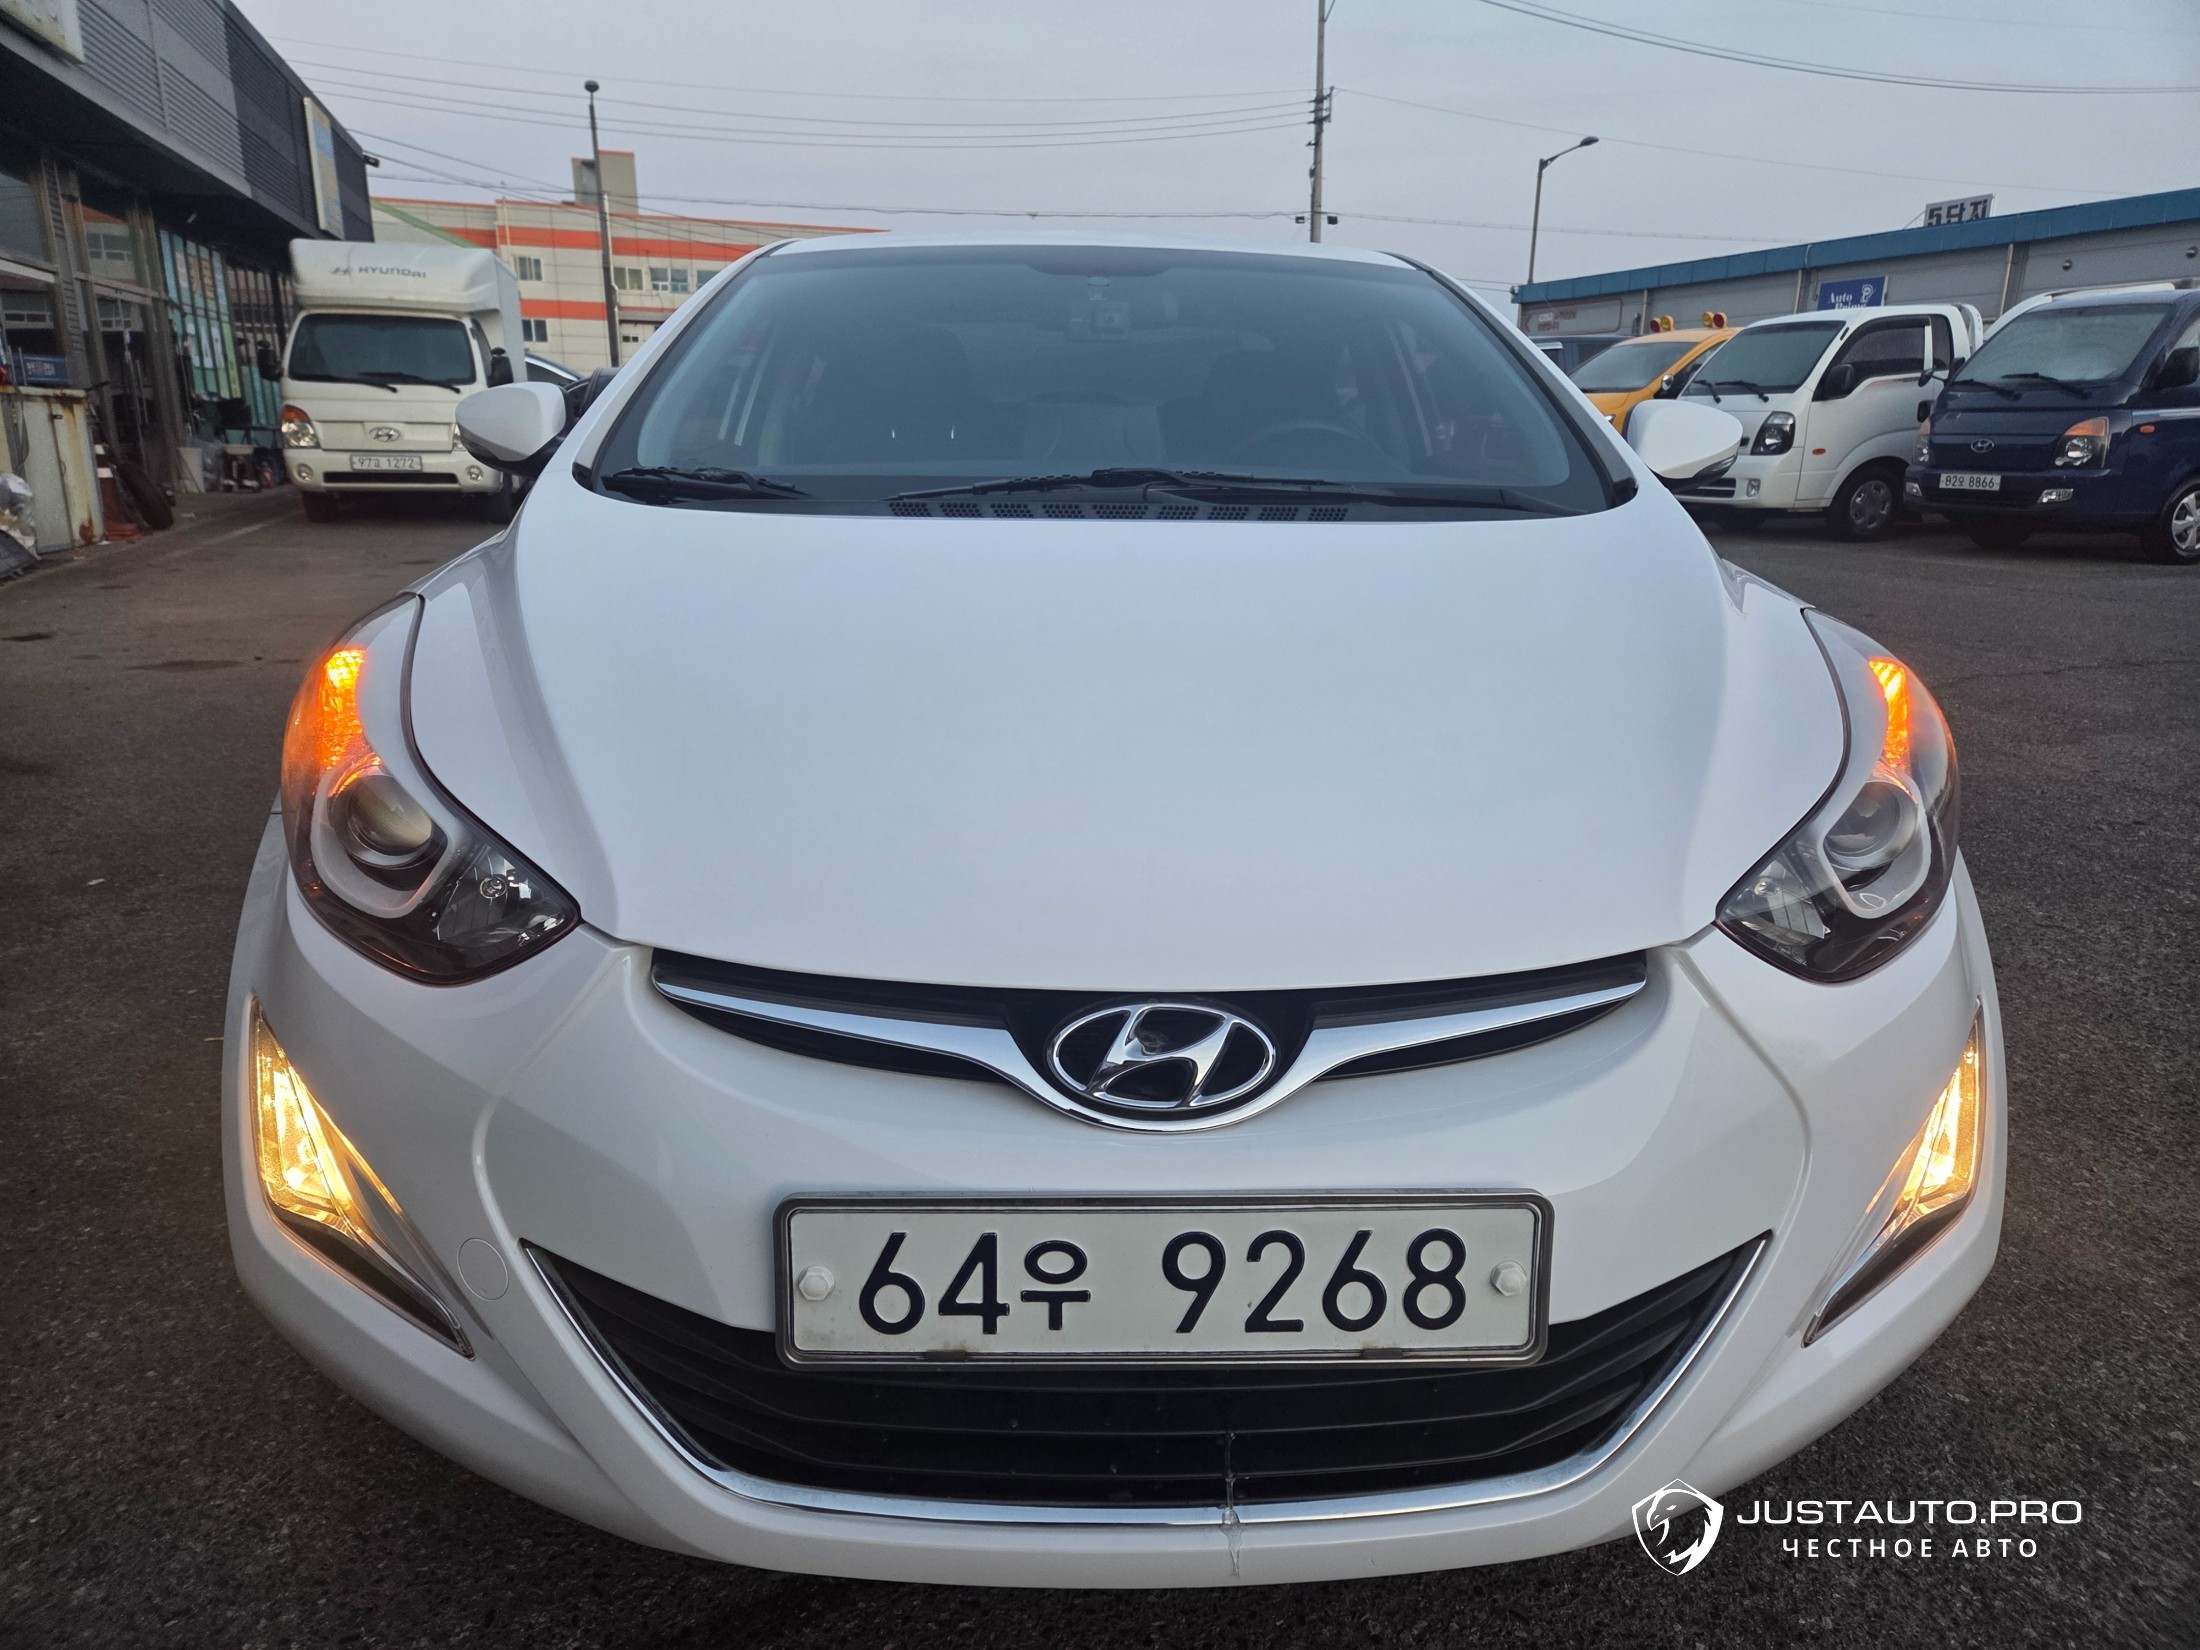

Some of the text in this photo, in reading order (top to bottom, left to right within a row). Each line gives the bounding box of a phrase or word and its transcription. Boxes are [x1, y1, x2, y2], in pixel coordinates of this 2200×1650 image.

[358, 266, 427, 279] HYUNDAI
[1828, 292, 1853, 304] Auto
[386, 457, 416, 469] 1272
[1968, 476, 1995, 488] 8866
[857, 1228, 1467, 1335] 64우 9268
